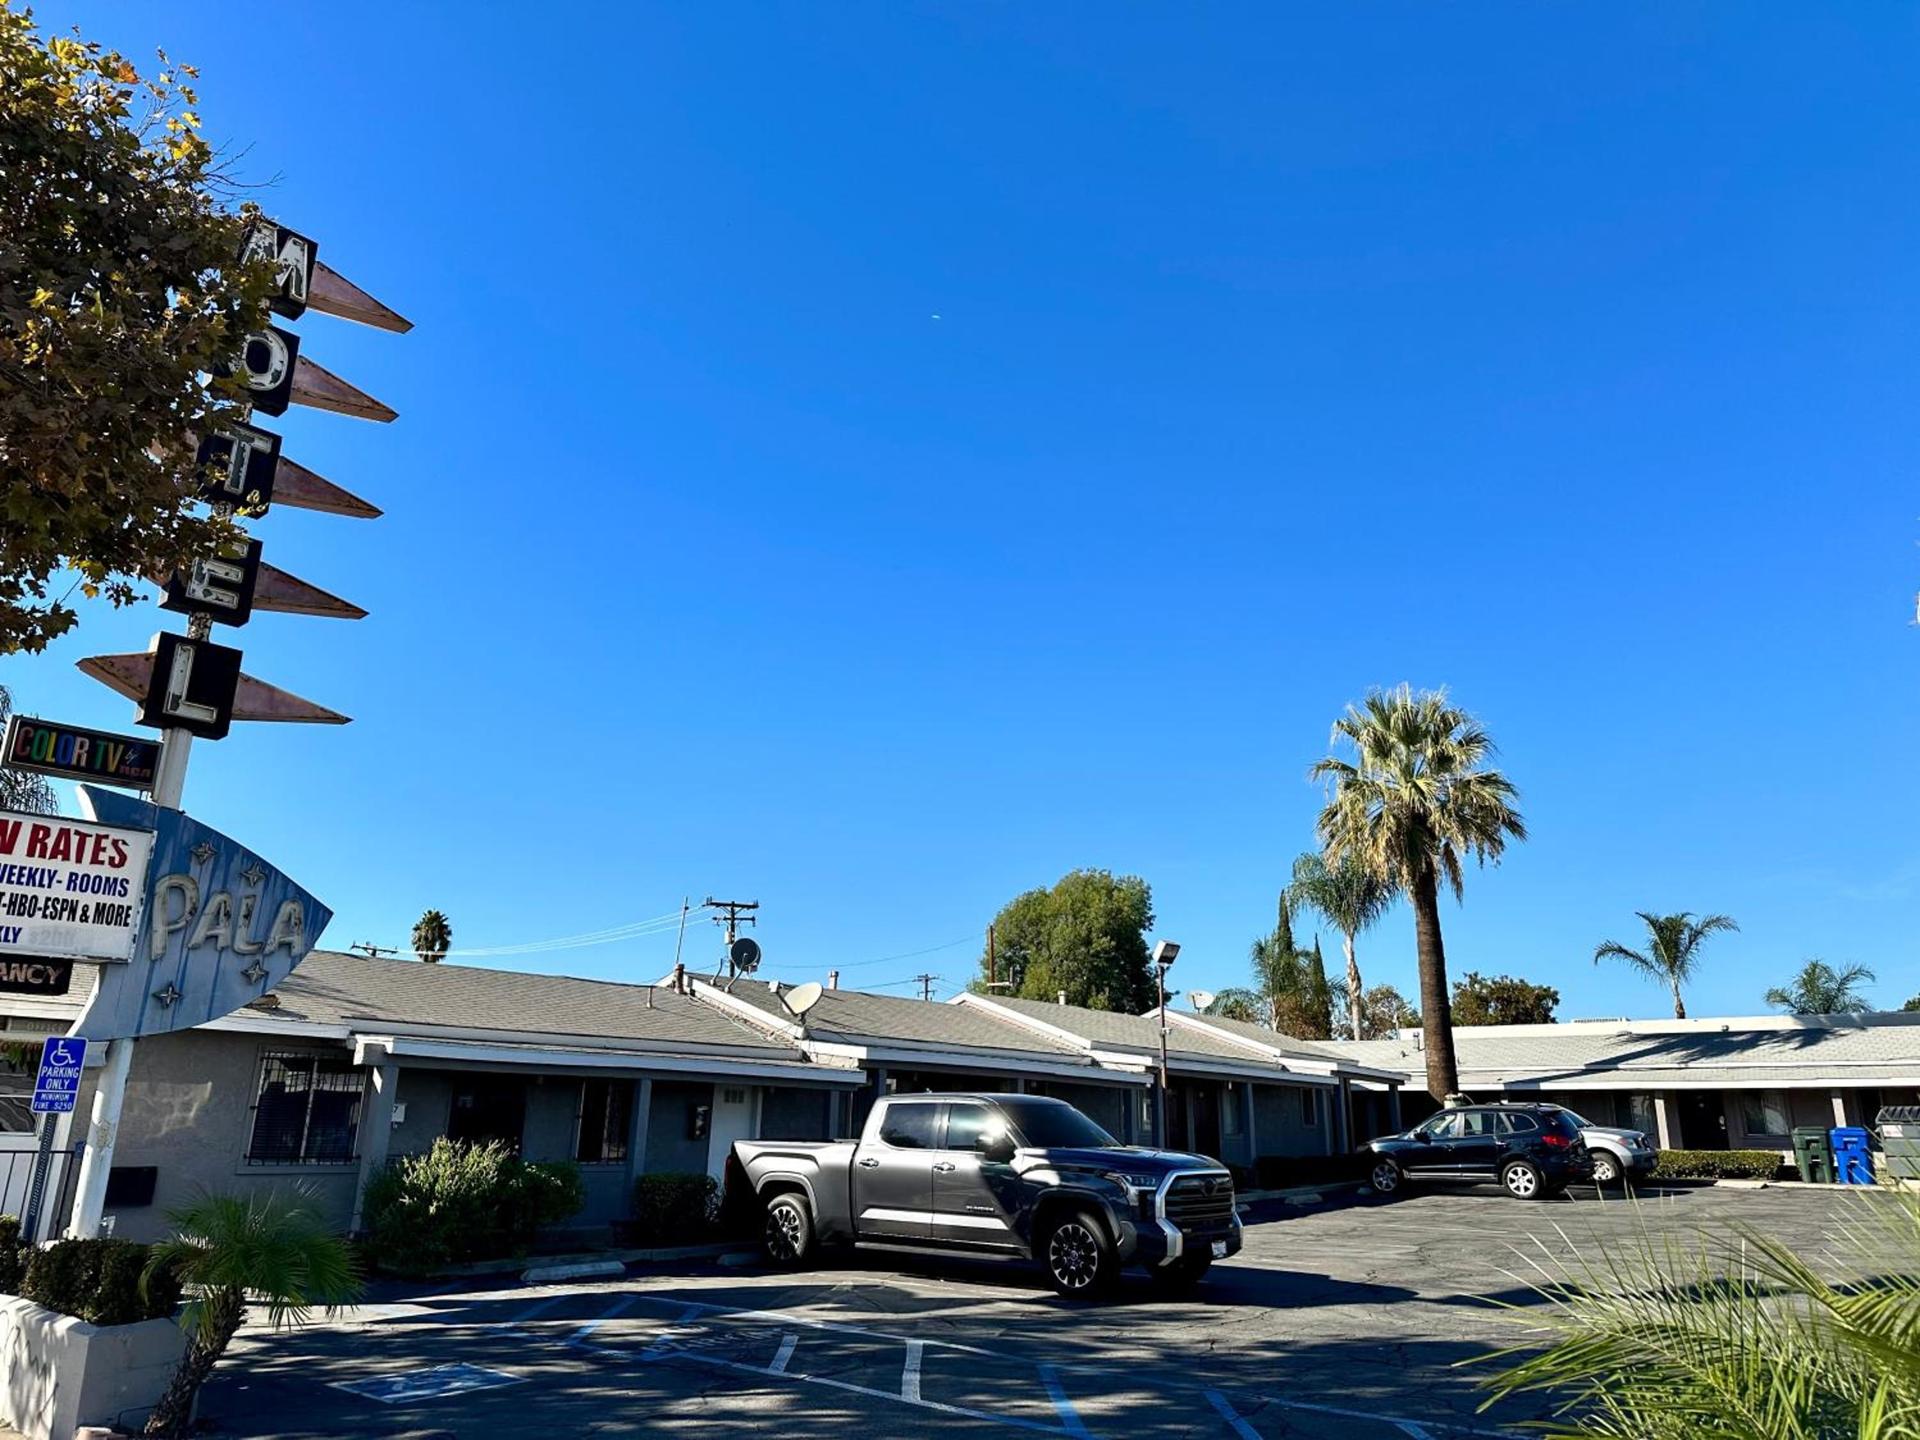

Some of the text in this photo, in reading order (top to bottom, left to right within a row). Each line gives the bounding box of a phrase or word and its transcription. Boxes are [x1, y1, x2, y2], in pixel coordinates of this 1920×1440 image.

[15, 726, 125, 774] COLOR TV
[26, 823, 130, 868] RATES
[66, 872, 130, 898] ROOMS
[79, 903, 91, 924] &
[92, 901, 132, 928] MORE
[148, 873, 305, 961] PALA
[40, 1066, 80, 1079] PARKING
[45, 1078, 70, 1090] ONLY
